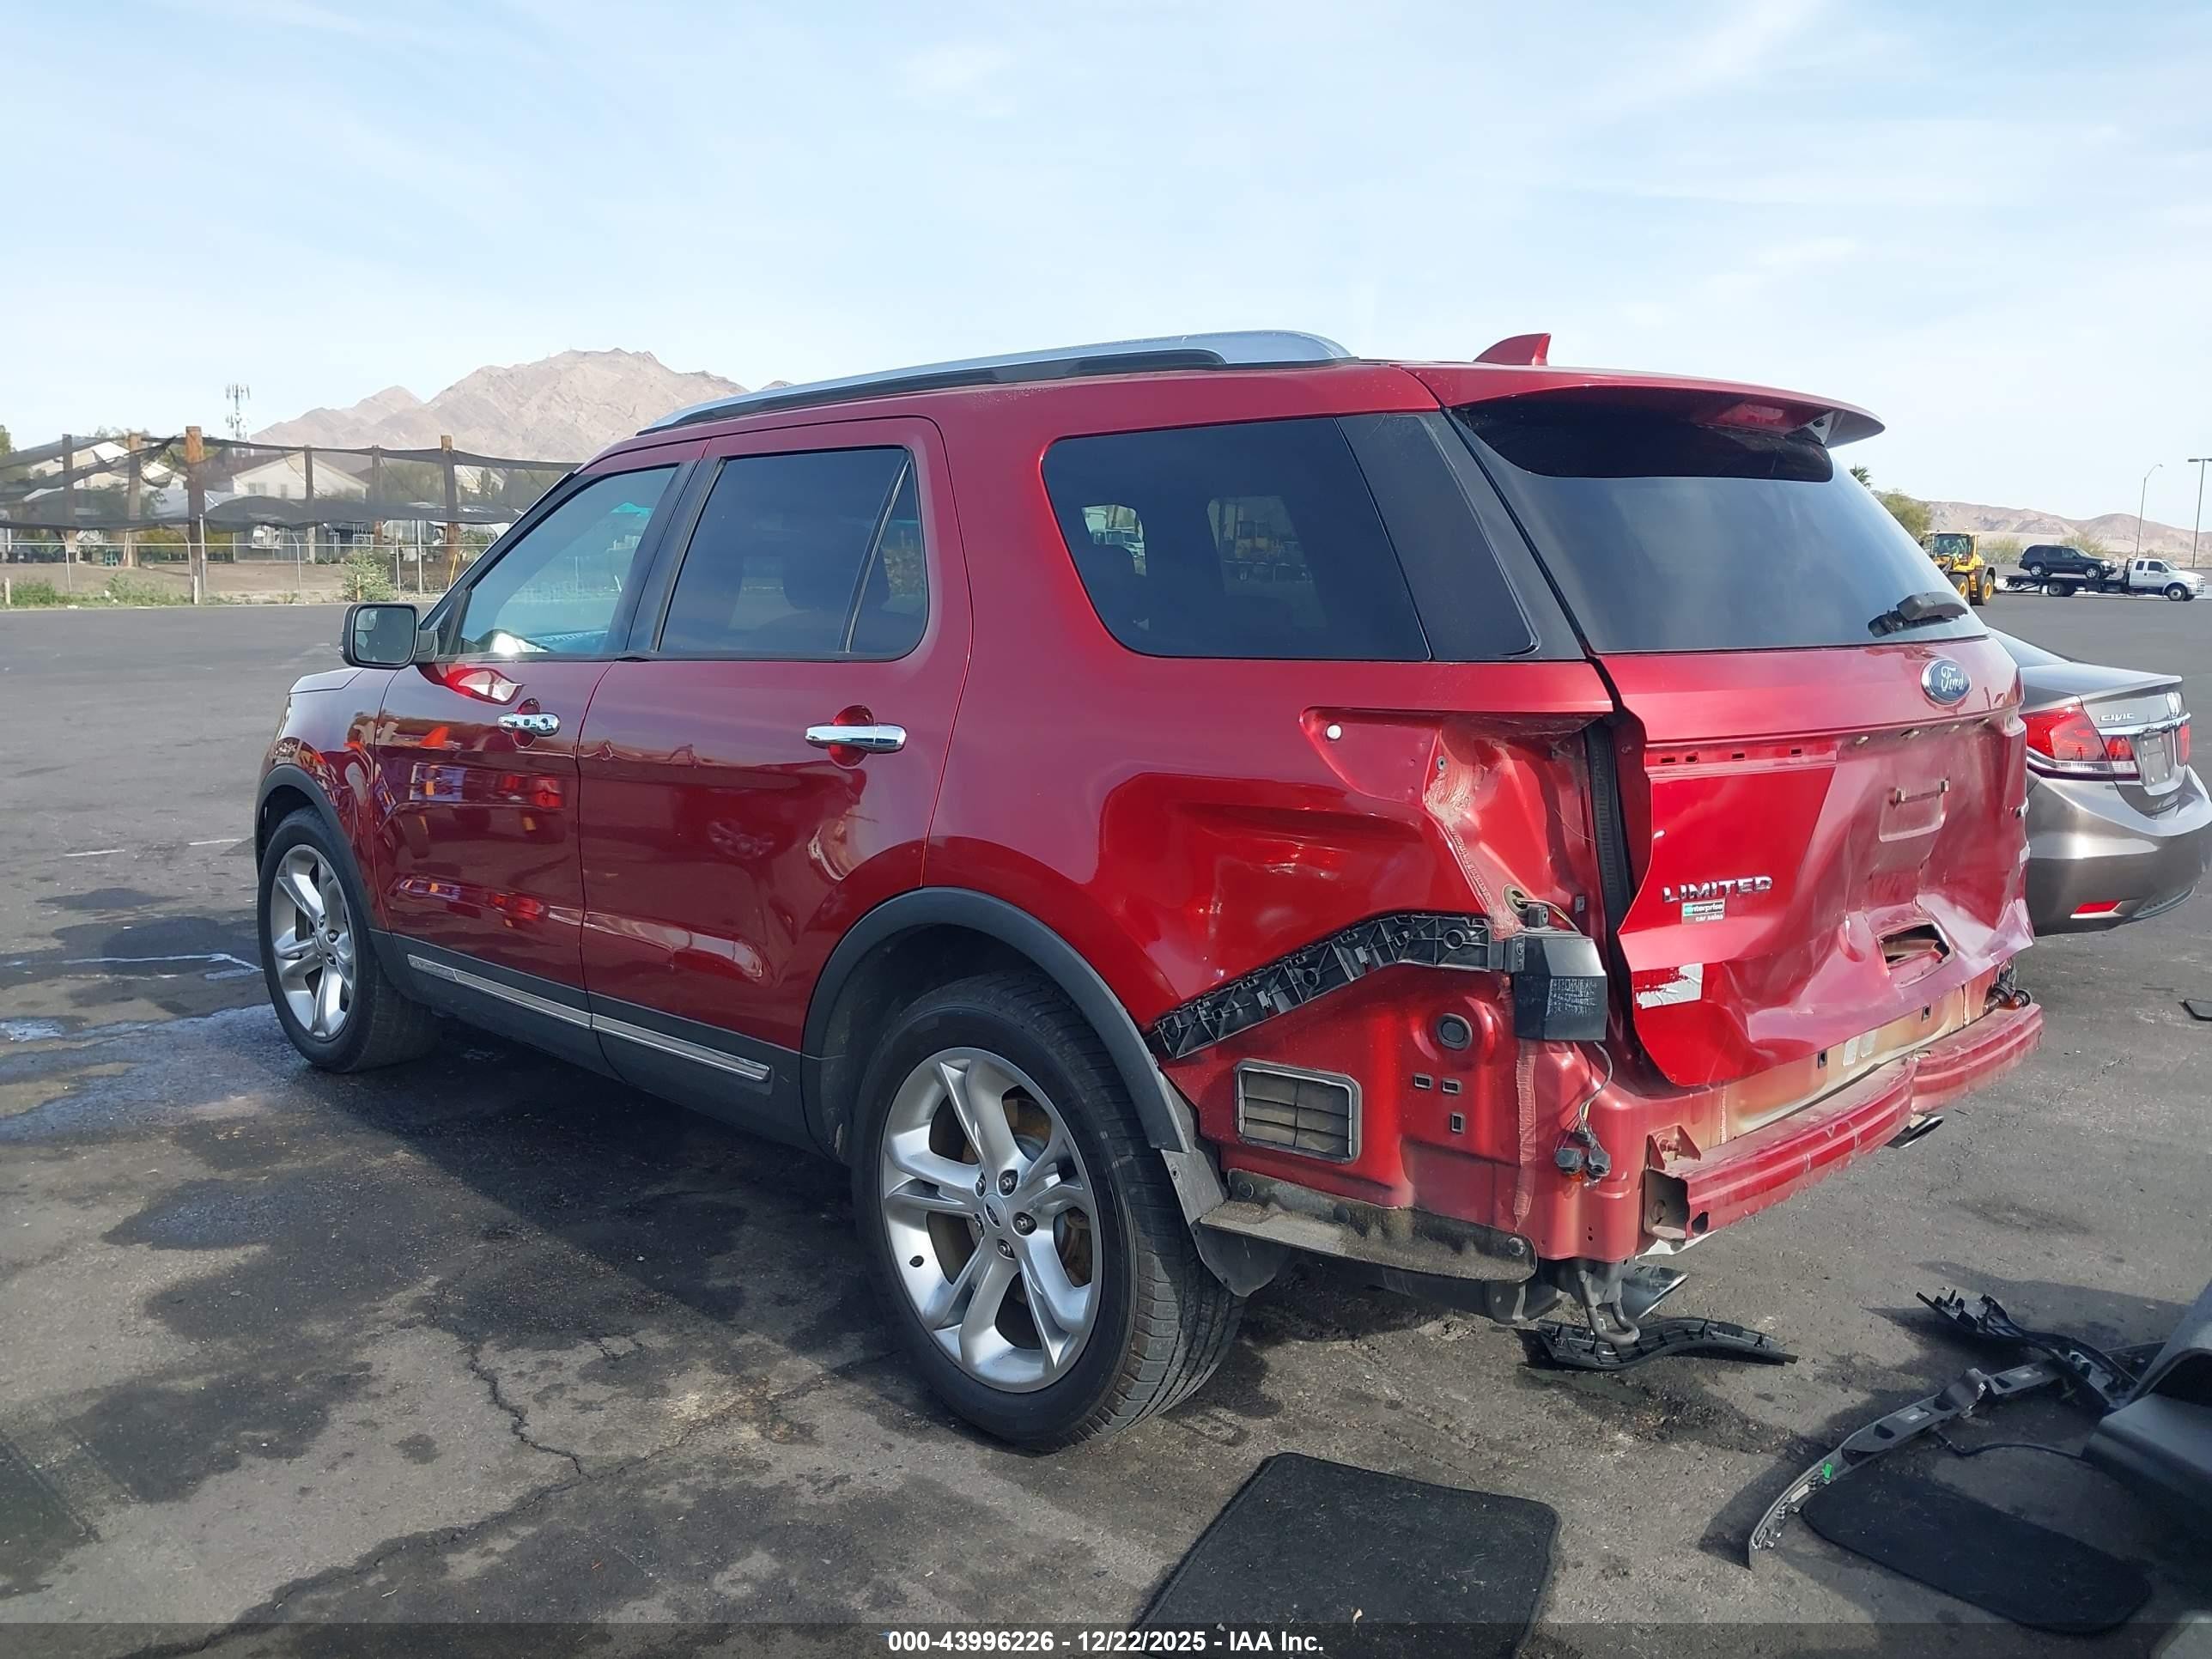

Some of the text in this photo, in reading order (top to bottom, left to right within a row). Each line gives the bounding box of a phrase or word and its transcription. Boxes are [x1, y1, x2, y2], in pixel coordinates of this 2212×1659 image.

[1941, 665, 1965, 692] Ford
[1662, 875, 1773, 902] LIMITED
[1684, 903, 1723, 914] enterprise
